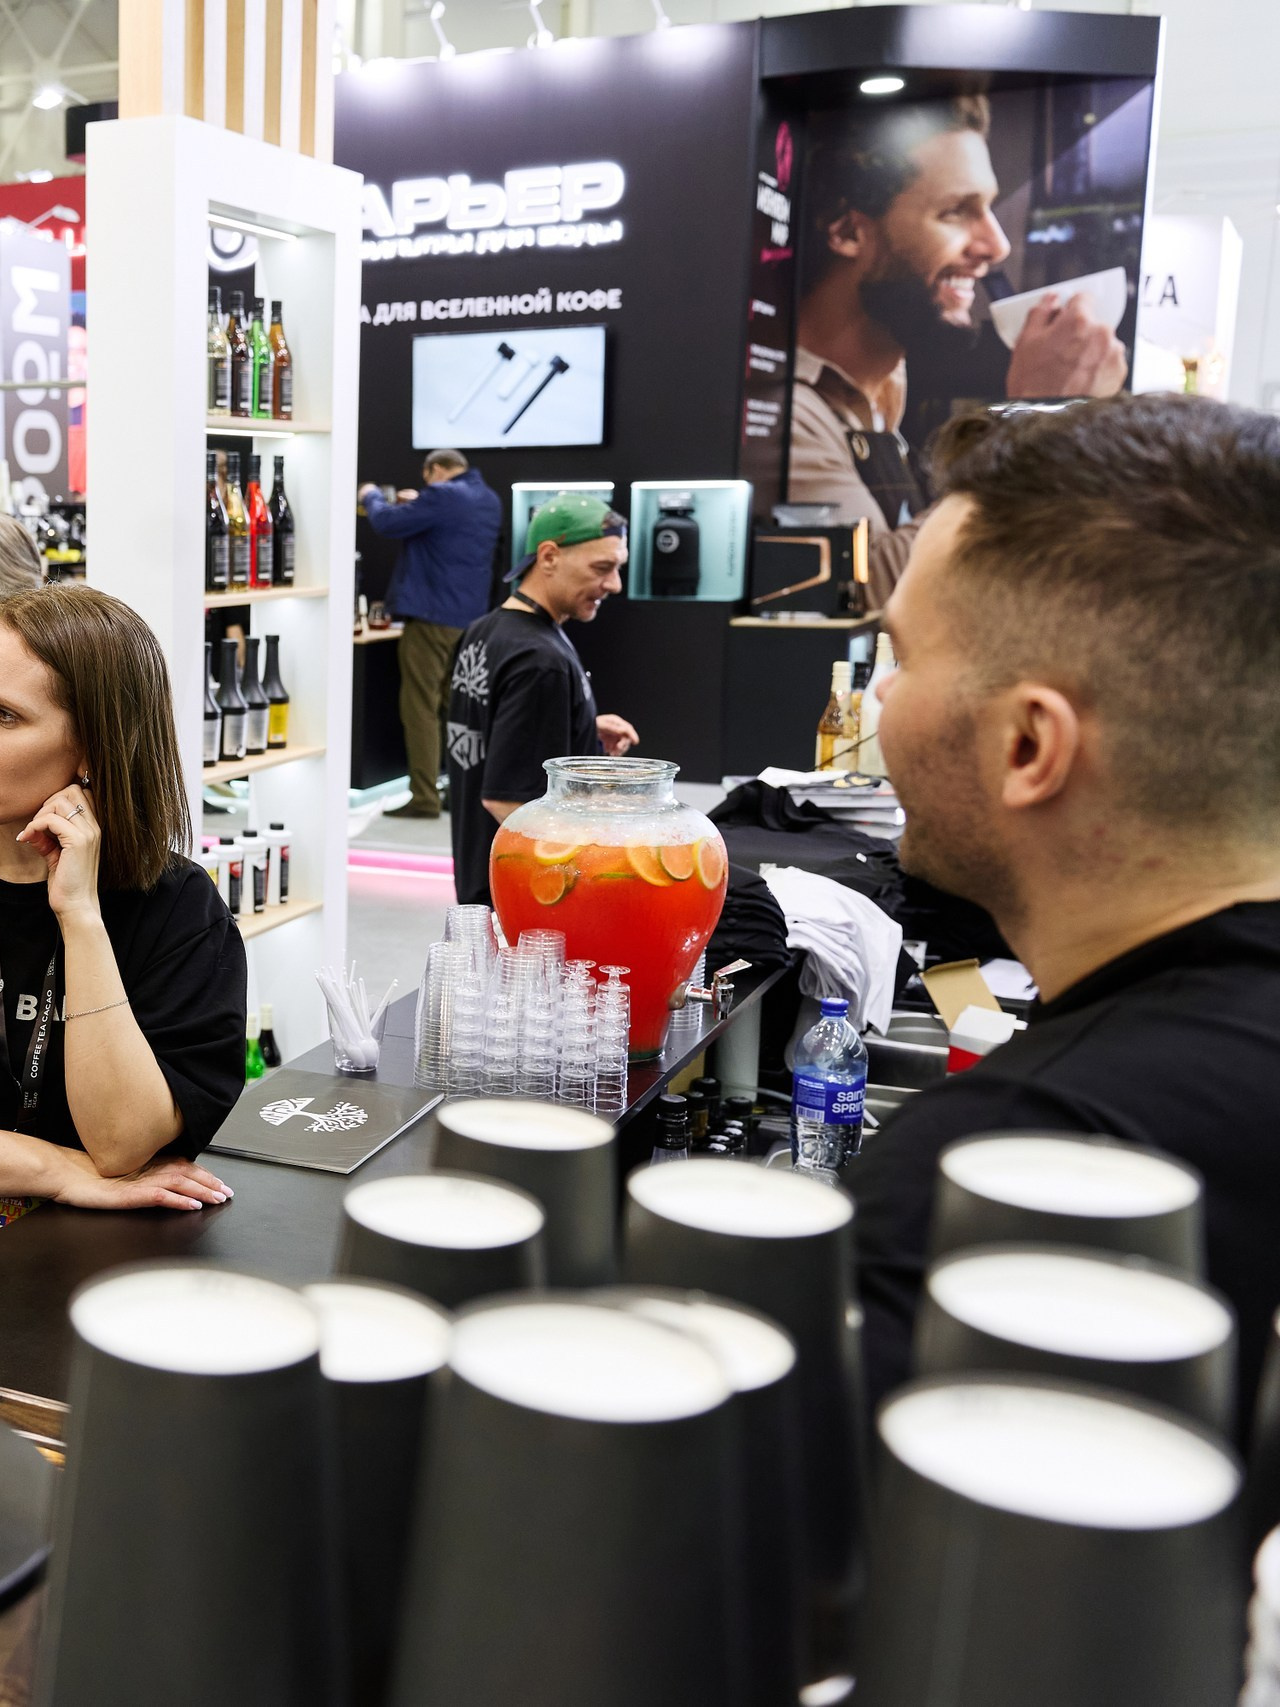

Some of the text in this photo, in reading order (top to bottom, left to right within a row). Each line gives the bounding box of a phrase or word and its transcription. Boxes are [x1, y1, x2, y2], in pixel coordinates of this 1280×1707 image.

[373, 301, 417, 326] ДЛЯ
[420, 287, 552, 321] ВСЕЛЕННОЙ
[556, 288, 623, 313] КОФЕ
[30, 989, 53, 1079] COFFEE TEA CACAO
